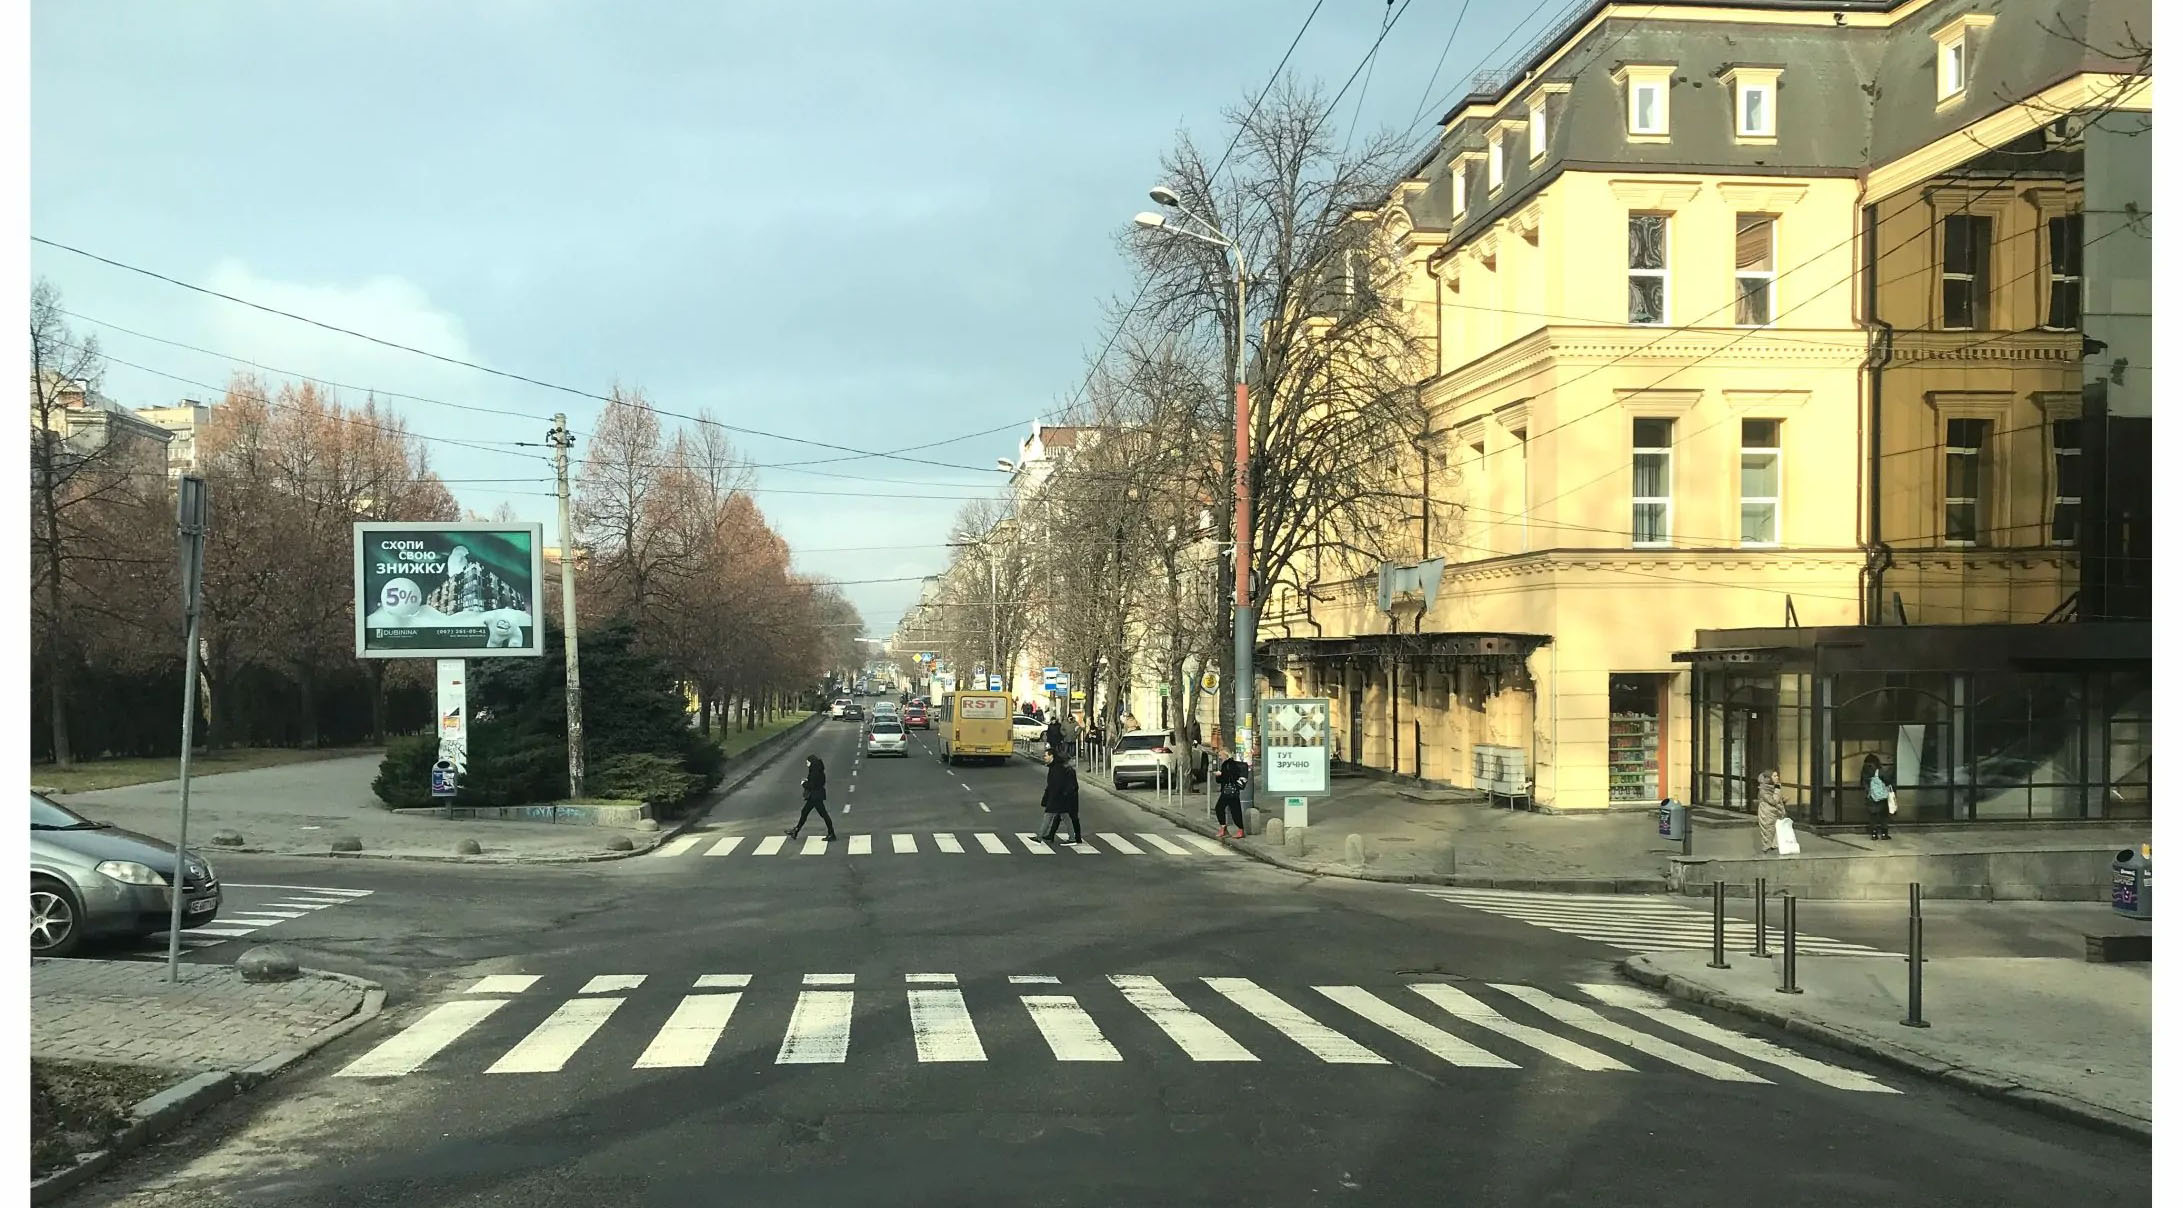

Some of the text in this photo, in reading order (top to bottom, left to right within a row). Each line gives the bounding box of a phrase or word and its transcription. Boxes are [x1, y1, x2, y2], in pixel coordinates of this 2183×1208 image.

[381, 540, 424, 550] СХОПИ
[398, 551, 436, 560] СВОЮ
[375, 562, 446, 574] ЗНИЖКУ
[386, 587, 418, 607] 5%
[963, 700, 998, 708] RST
